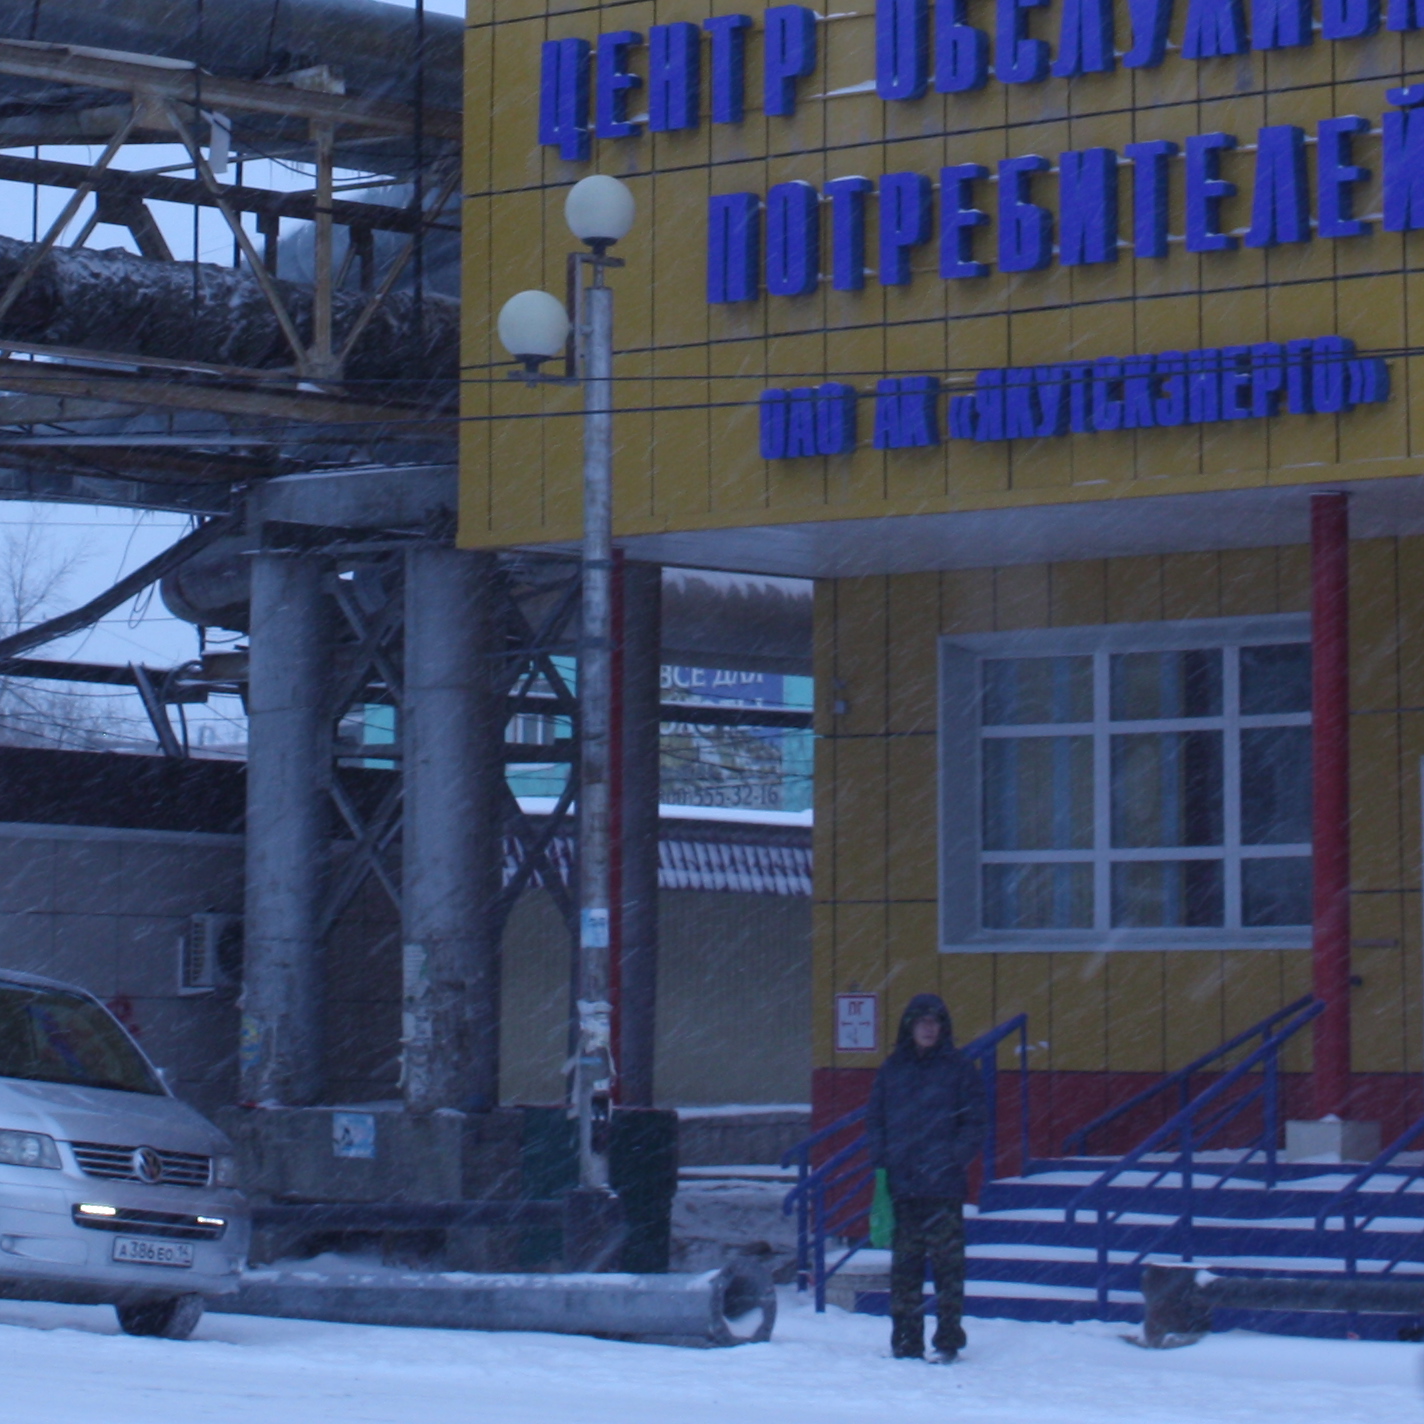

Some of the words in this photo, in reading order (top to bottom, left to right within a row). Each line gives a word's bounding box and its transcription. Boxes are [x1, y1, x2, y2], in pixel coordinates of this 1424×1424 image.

[538, 4, 817, 162] ЦЕНТР
[760, 382, 857, 460] ОАО
[872, 376, 941, 450] АК
